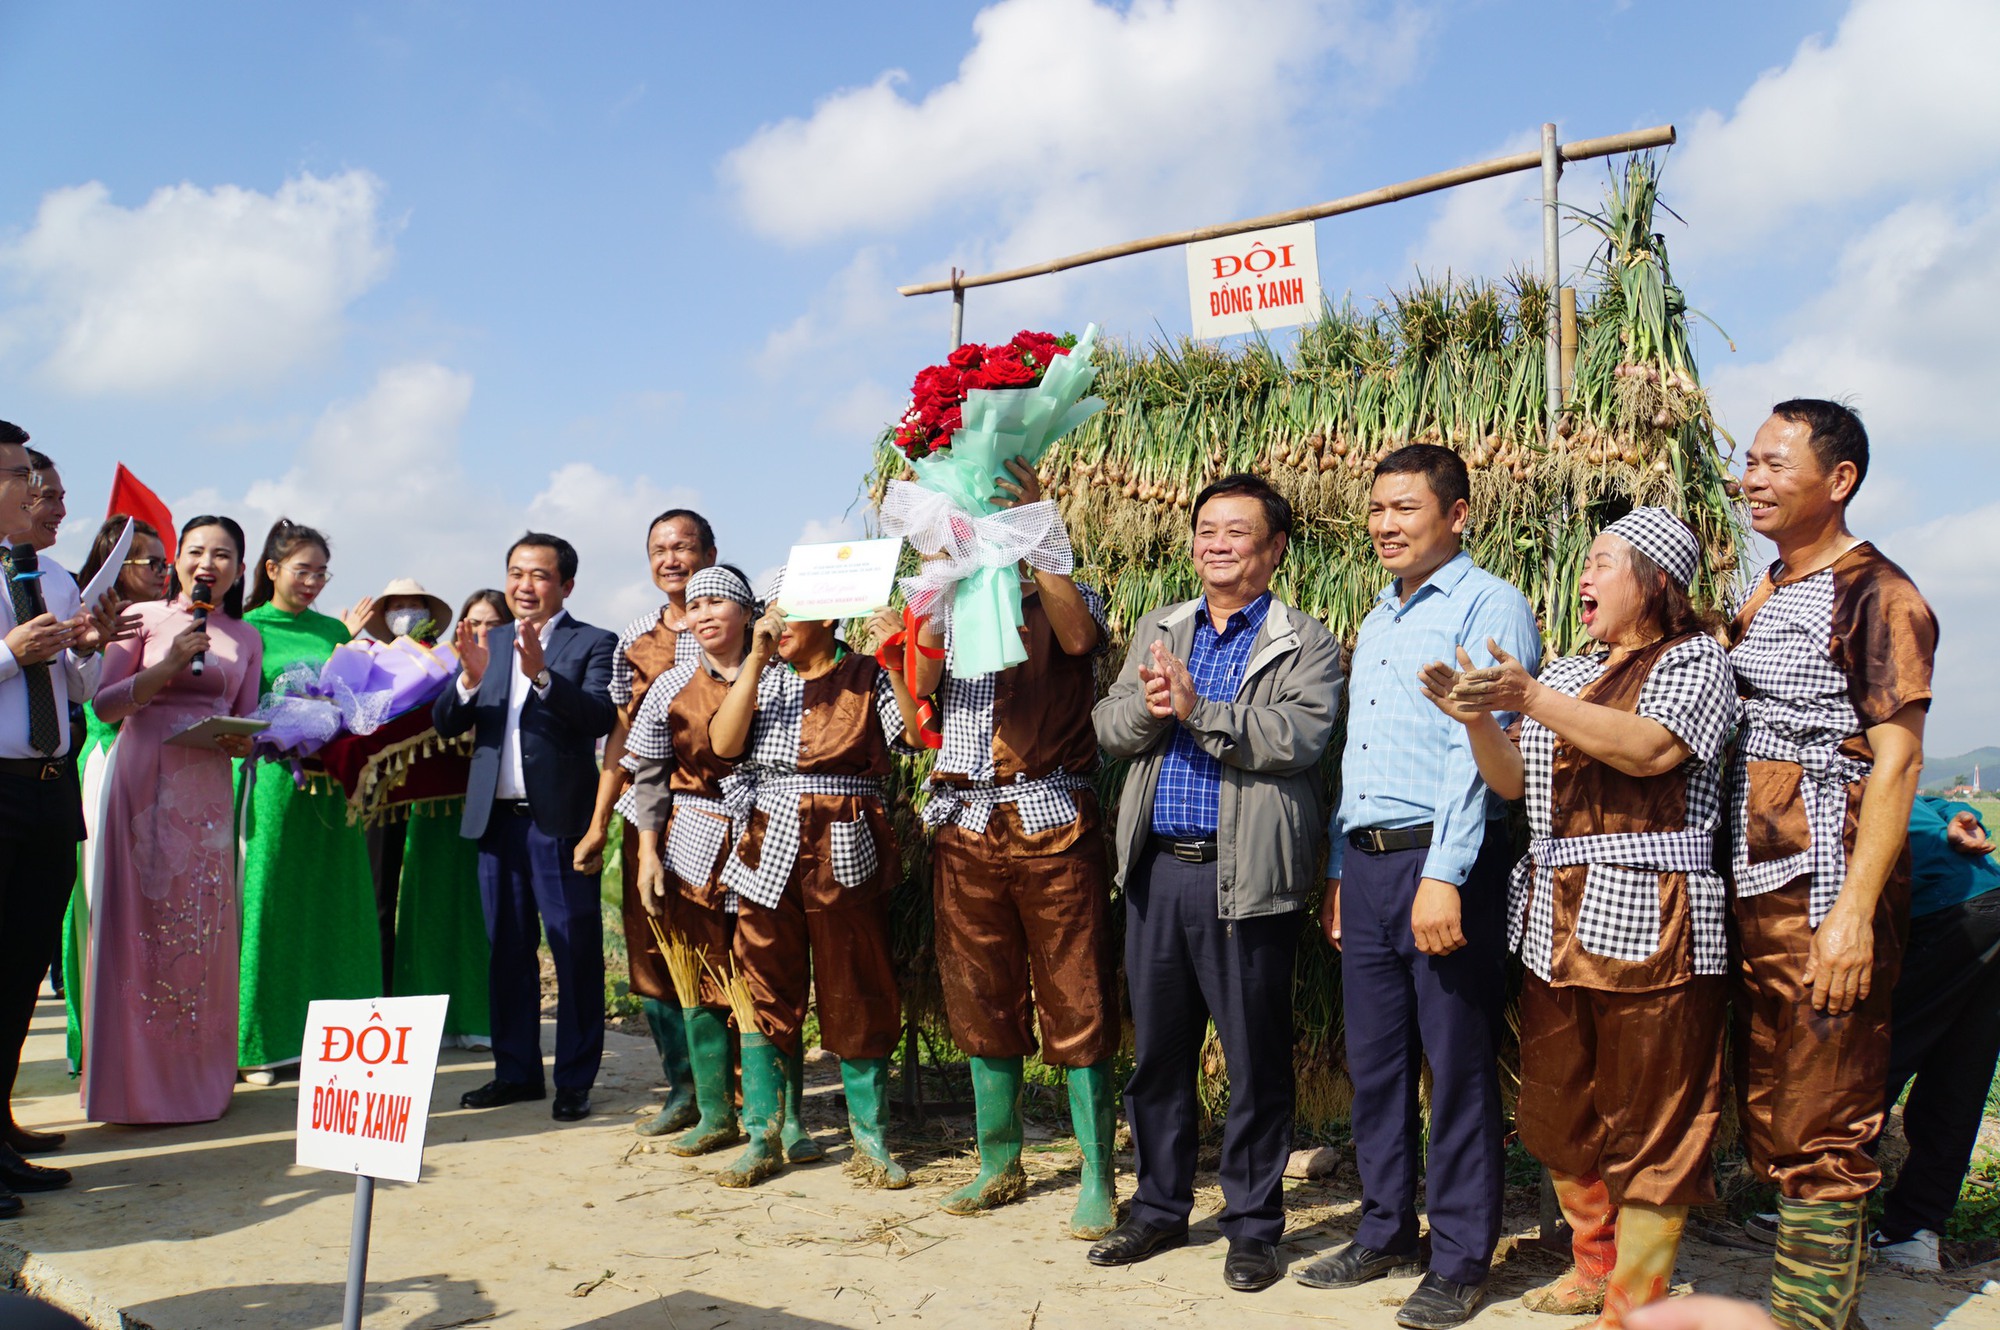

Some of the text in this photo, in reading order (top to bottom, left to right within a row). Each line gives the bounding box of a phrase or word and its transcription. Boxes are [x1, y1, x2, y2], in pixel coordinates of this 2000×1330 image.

[1210, 240, 1297, 280] ĐỘI
[1209, 277, 1305, 317] ĐỒNG XANH
[318, 1011, 413, 1079] ĐỘI
[311, 1074, 413, 1144] ĐỒNG XANH
